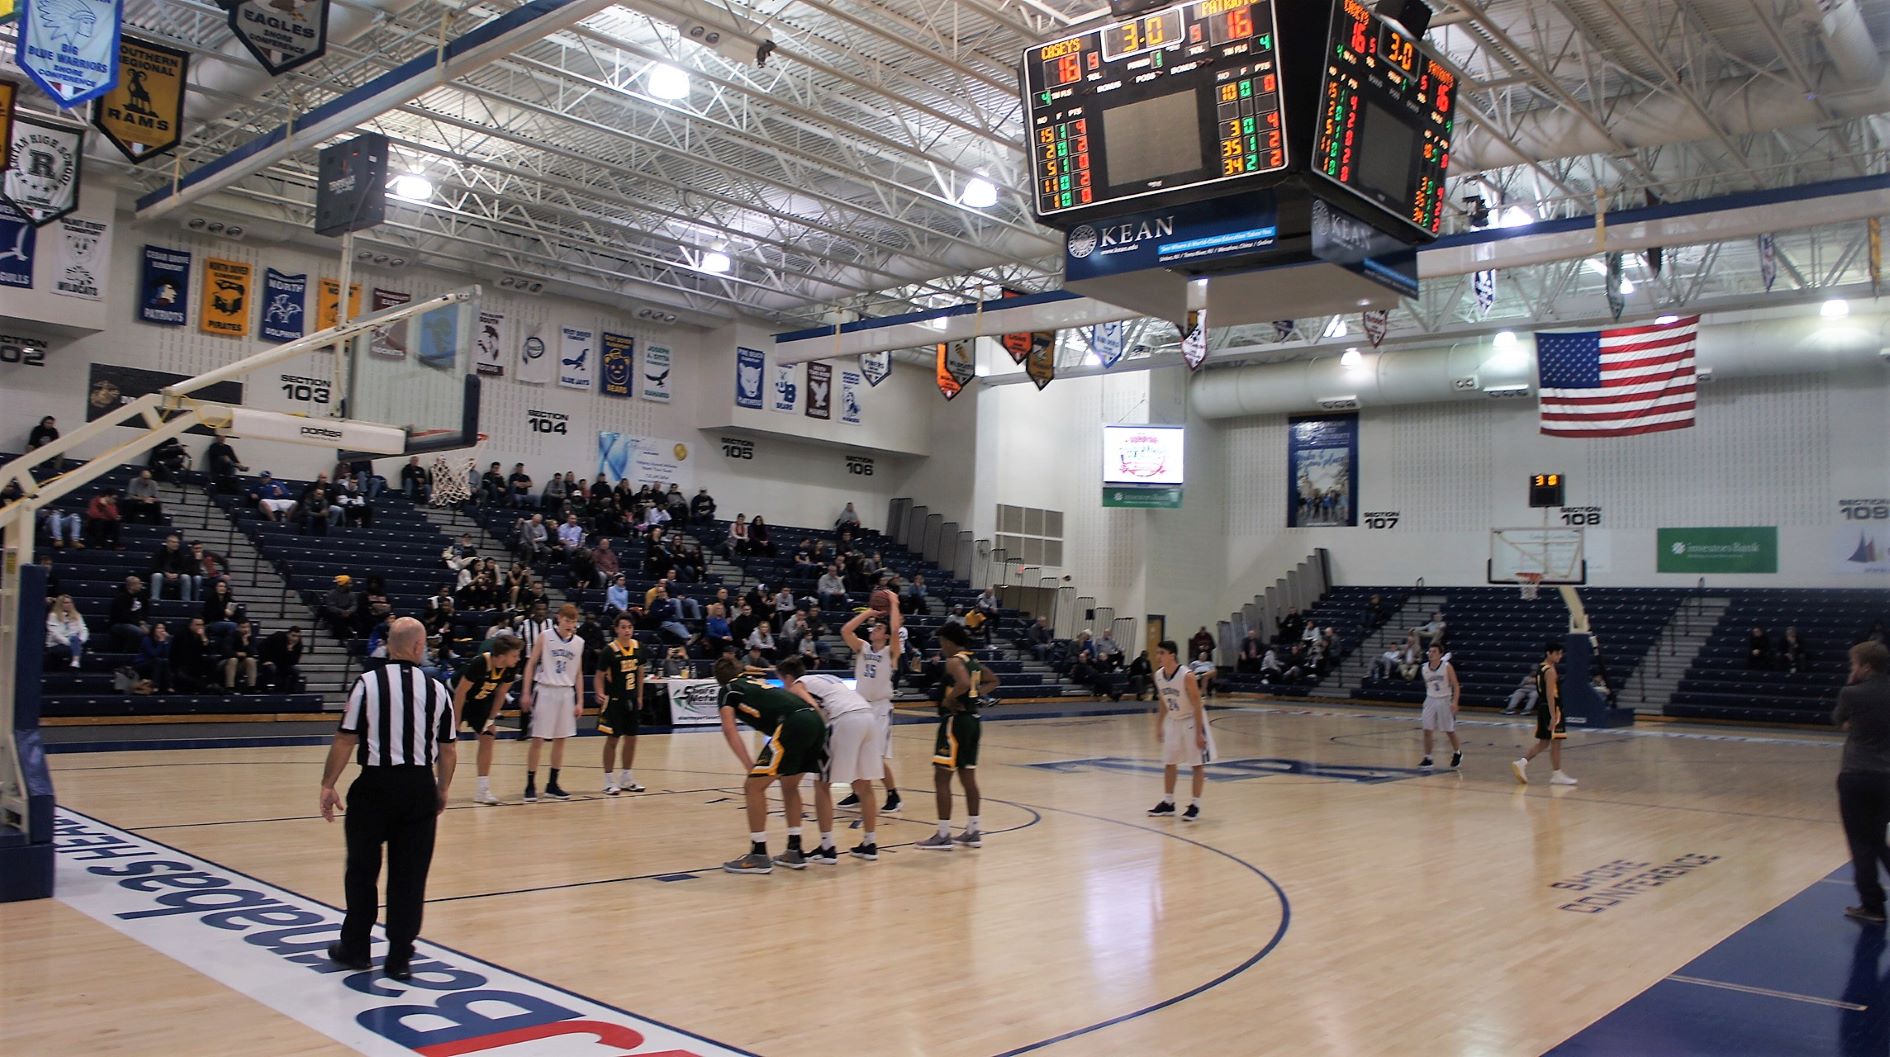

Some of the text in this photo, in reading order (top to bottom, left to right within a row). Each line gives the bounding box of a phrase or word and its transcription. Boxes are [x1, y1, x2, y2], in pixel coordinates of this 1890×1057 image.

[1201, 0, 1260, 17] PATRIO
[244, 9, 314, 38] EAGLES
[1227, 8, 1253, 39] 16
[264, 29, 293, 43] SHORE
[1121, 17, 1164, 52] 3.0
[1260, 34, 1271, 49] 4
[61, 43, 79, 55] BIG
[250, 33, 305, 54] CONFERENCE
[1041, 38, 1080, 60] CASEYS
[1388, 32, 1412, 70] 3.0
[28, 45, 108, 73] BLUE WARRIORS
[120, 45, 178, 67] OUTHERN
[53, 64, 84, 77] SHORE
[119, 55, 175, 76] EGIONAL
[1058, 55, 1081, 83] 16
[38, 68, 96, 87] CONFERENCE
[1041, 90, 1052, 105] 4
[1222, 84, 1237, 101] 10
[108, 108, 168, 131] RAMS
[1231, 119, 1240, 136] 3
[29, 134, 59, 149] HIGH
[1041, 128, 1054, 142] 15
[1046, 144, 1055, 159] 2
[1223, 140, 1242, 157] 35
[1269, 130, 1280, 148] 2
[28, 149, 56, 179] R
[1047, 160, 1057, 175] 5
[1224, 157, 1244, 175] 34
[1246, 154, 1257, 171] 2
[1045, 176, 1058, 193] 11
[1100, 216, 1174, 247] KEAN
[57, 281, 98, 296] WILDCATS
[269, 281, 303, 292] NORTH
[145, 308, 184, 322] PATRIOTS
[208, 320, 241, 331] PIRATES
[0, 335, 47, 348] ECTION
[281, 374, 332, 387] SECTION
[281, 385, 330, 404] 103
[528, 409, 569, 421] SECTION
[528, 419, 567, 435] 104
[722, 437, 754, 447] SECTION
[722, 445, 753, 460] 105
[845, 456, 874, 464] SECTION
[845, 463, 873, 476] 106
[1561, 513, 1600, 525] 108
[1840, 506, 1889, 520] 109
[1364, 518, 1399, 529] 107
[625, 673, 636, 690] 2
[1549, 859, 1652, 892] SHORE
[1557, 853, 1722, 914] CONFERENCE
